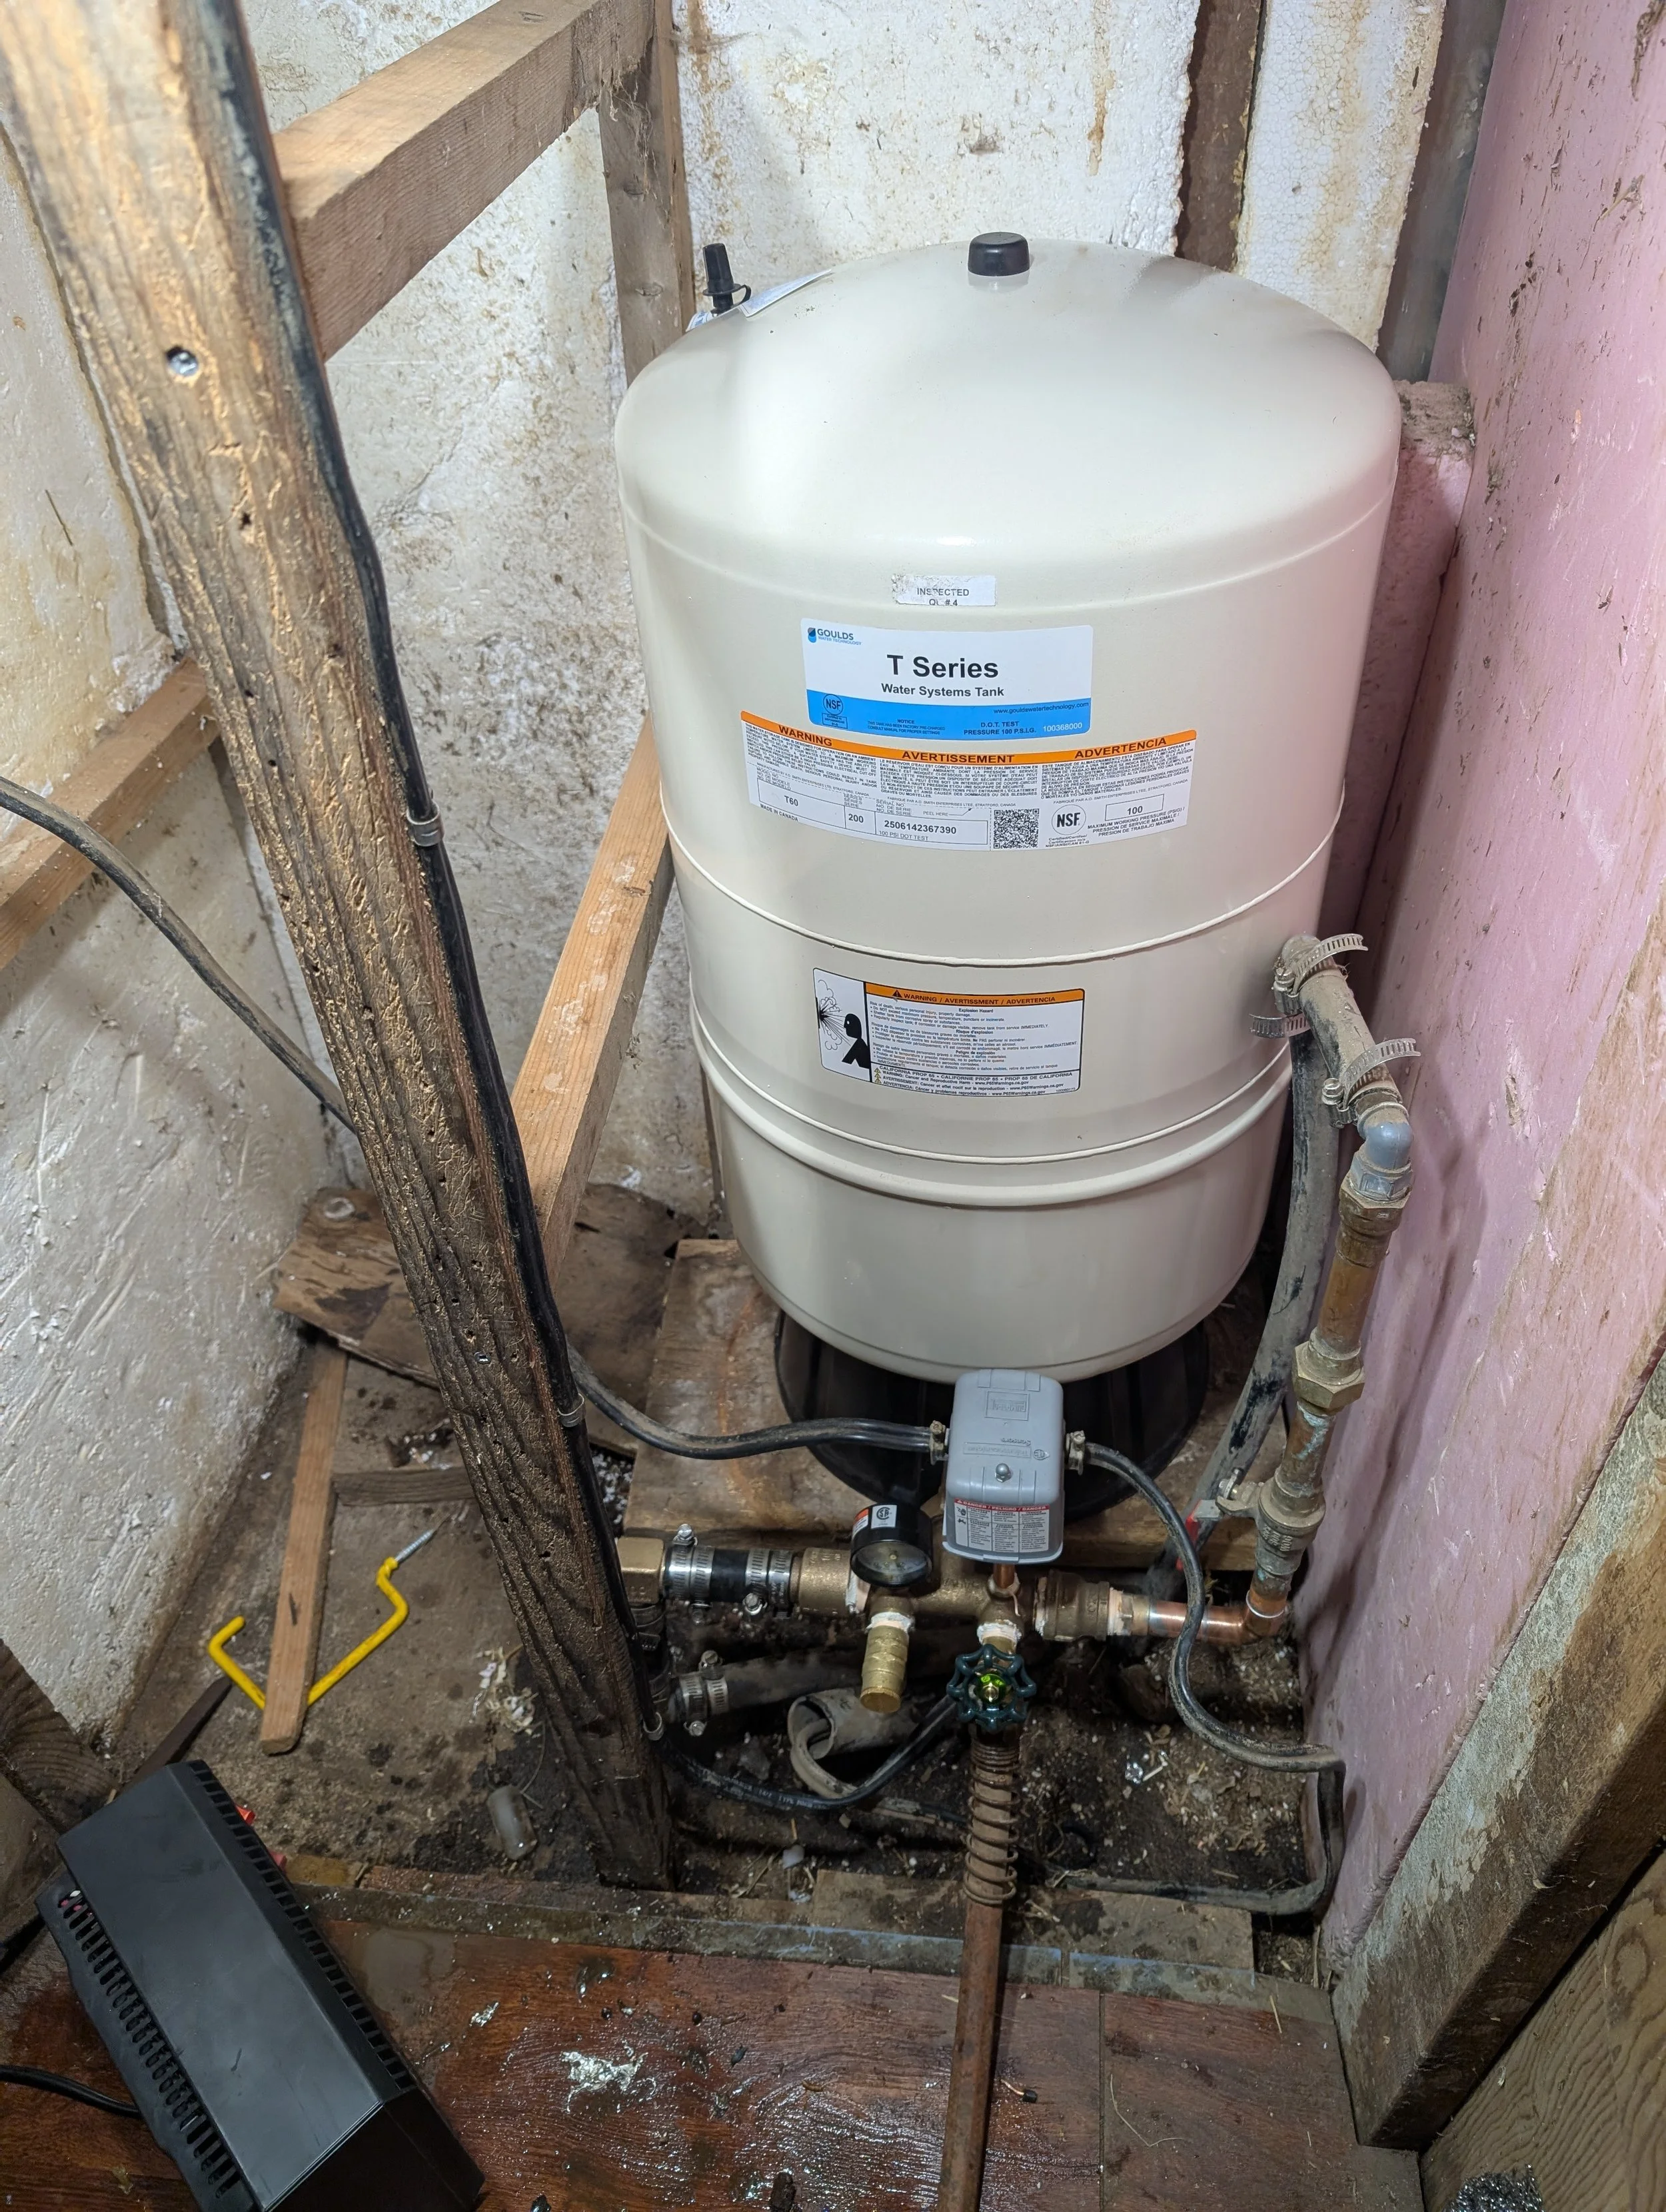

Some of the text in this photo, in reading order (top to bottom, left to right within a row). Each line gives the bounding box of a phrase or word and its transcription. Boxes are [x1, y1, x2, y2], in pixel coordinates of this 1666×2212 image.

[817, 629, 854, 641] GOULDS
[887, 654, 998, 678] T Series
[881, 683, 1004, 698] Water Systems Tank
[826, 699, 842, 710] NSF
[994, 702, 1089, 714] www.gouldswatertechnology.com
[1044, 722, 1083, 732] 100368000
[779, 725, 832, 746] WARNING
[1074, 738, 1167, 759] ADVERTENCIA
[902, 751, 1014, 764] AVERTISSEMENT
[784, 796, 798, 806] T60
[760, 804, 772, 813] MADE
[779, 812, 798, 822] CANADA
[1127, 806, 1143, 815] 100
[848, 814, 864, 824] 200
[1057, 812, 1080, 828] NSF
[1088, 821, 1113, 830] MAXIMUM
[1140, 811, 1166, 821] PRESSURE
[1131, 823, 1154, 831] TRABAJO
[1155, 818, 1174, 827] MAXIMA
[1151, 814, 1176, 824] MAXIMALE
[884, 820, 956, 834] 2506142367390
[904, 993, 937, 1002] WARNING
[879, 1065, 910, 1075] CALIFORNIA
[883, 1075, 918, 1085] AVERTISSEMENT:
